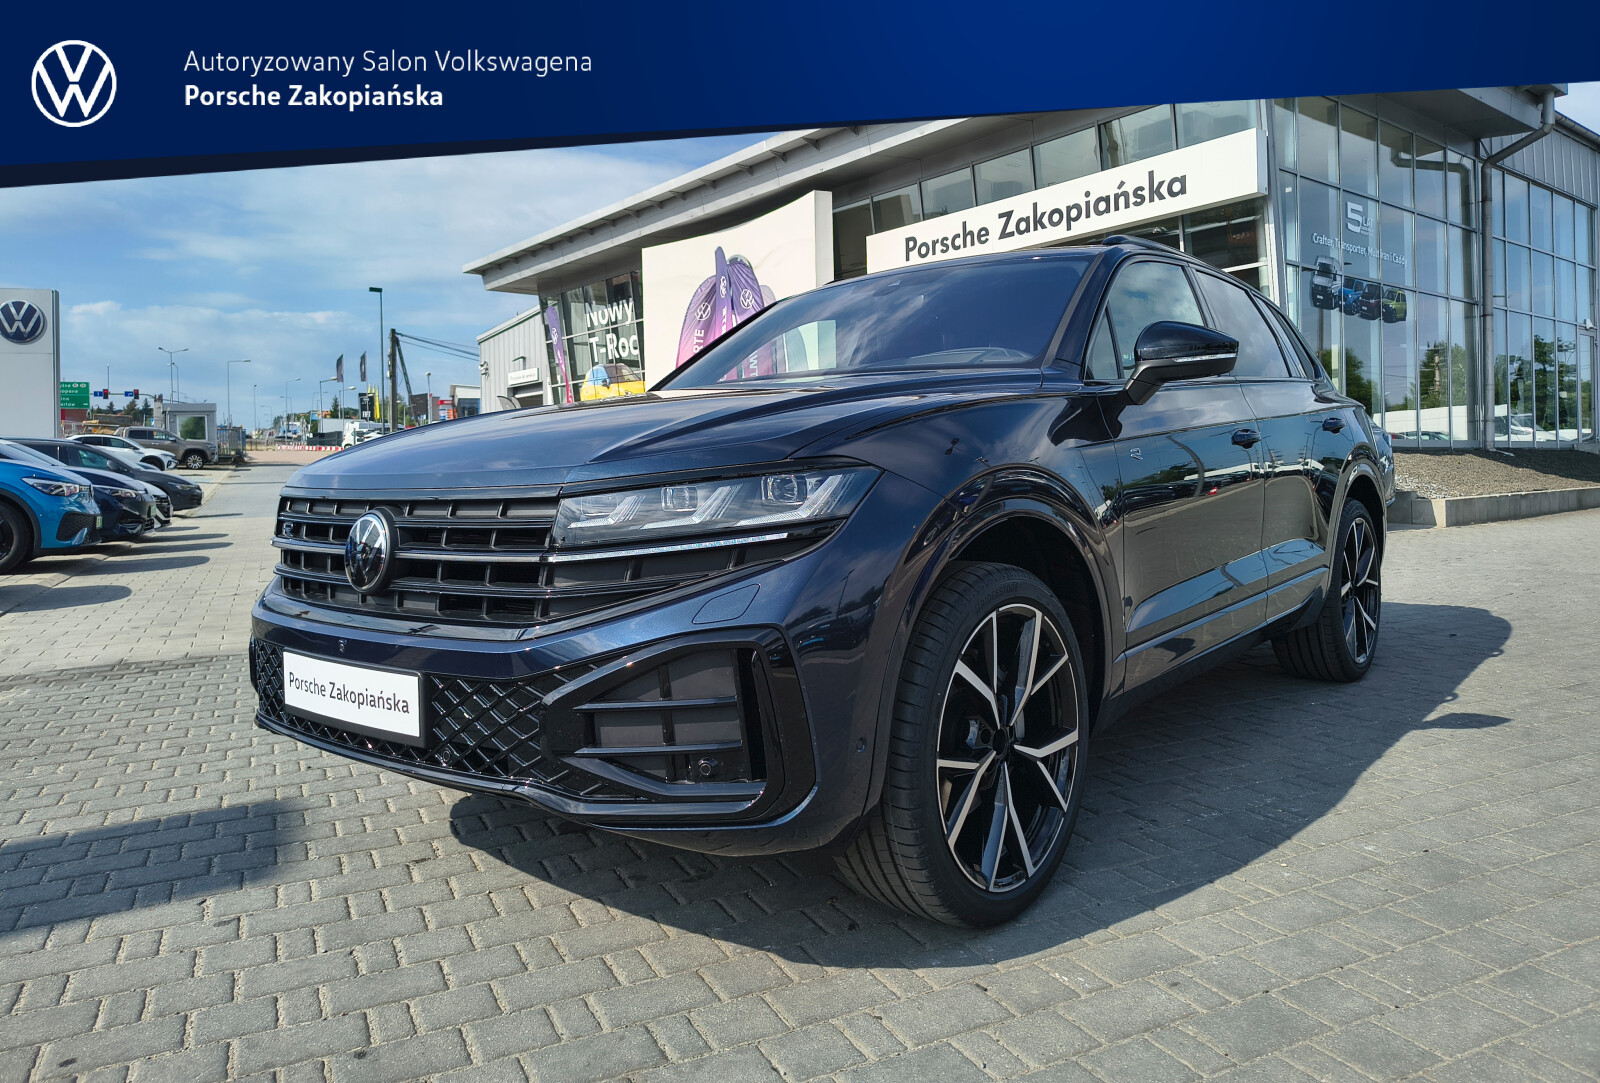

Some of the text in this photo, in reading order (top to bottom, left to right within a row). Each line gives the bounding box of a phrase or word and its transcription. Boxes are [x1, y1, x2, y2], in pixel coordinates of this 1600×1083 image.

[905, 170, 1187, 262] Porsche Zakopiańska
[1346, 201, 1363, 234] 5
[585, 298, 633, 327] Nowy
[589, 333, 640, 362] T-Roc
[289, 671, 410, 714] Porsche Zakopiańska
